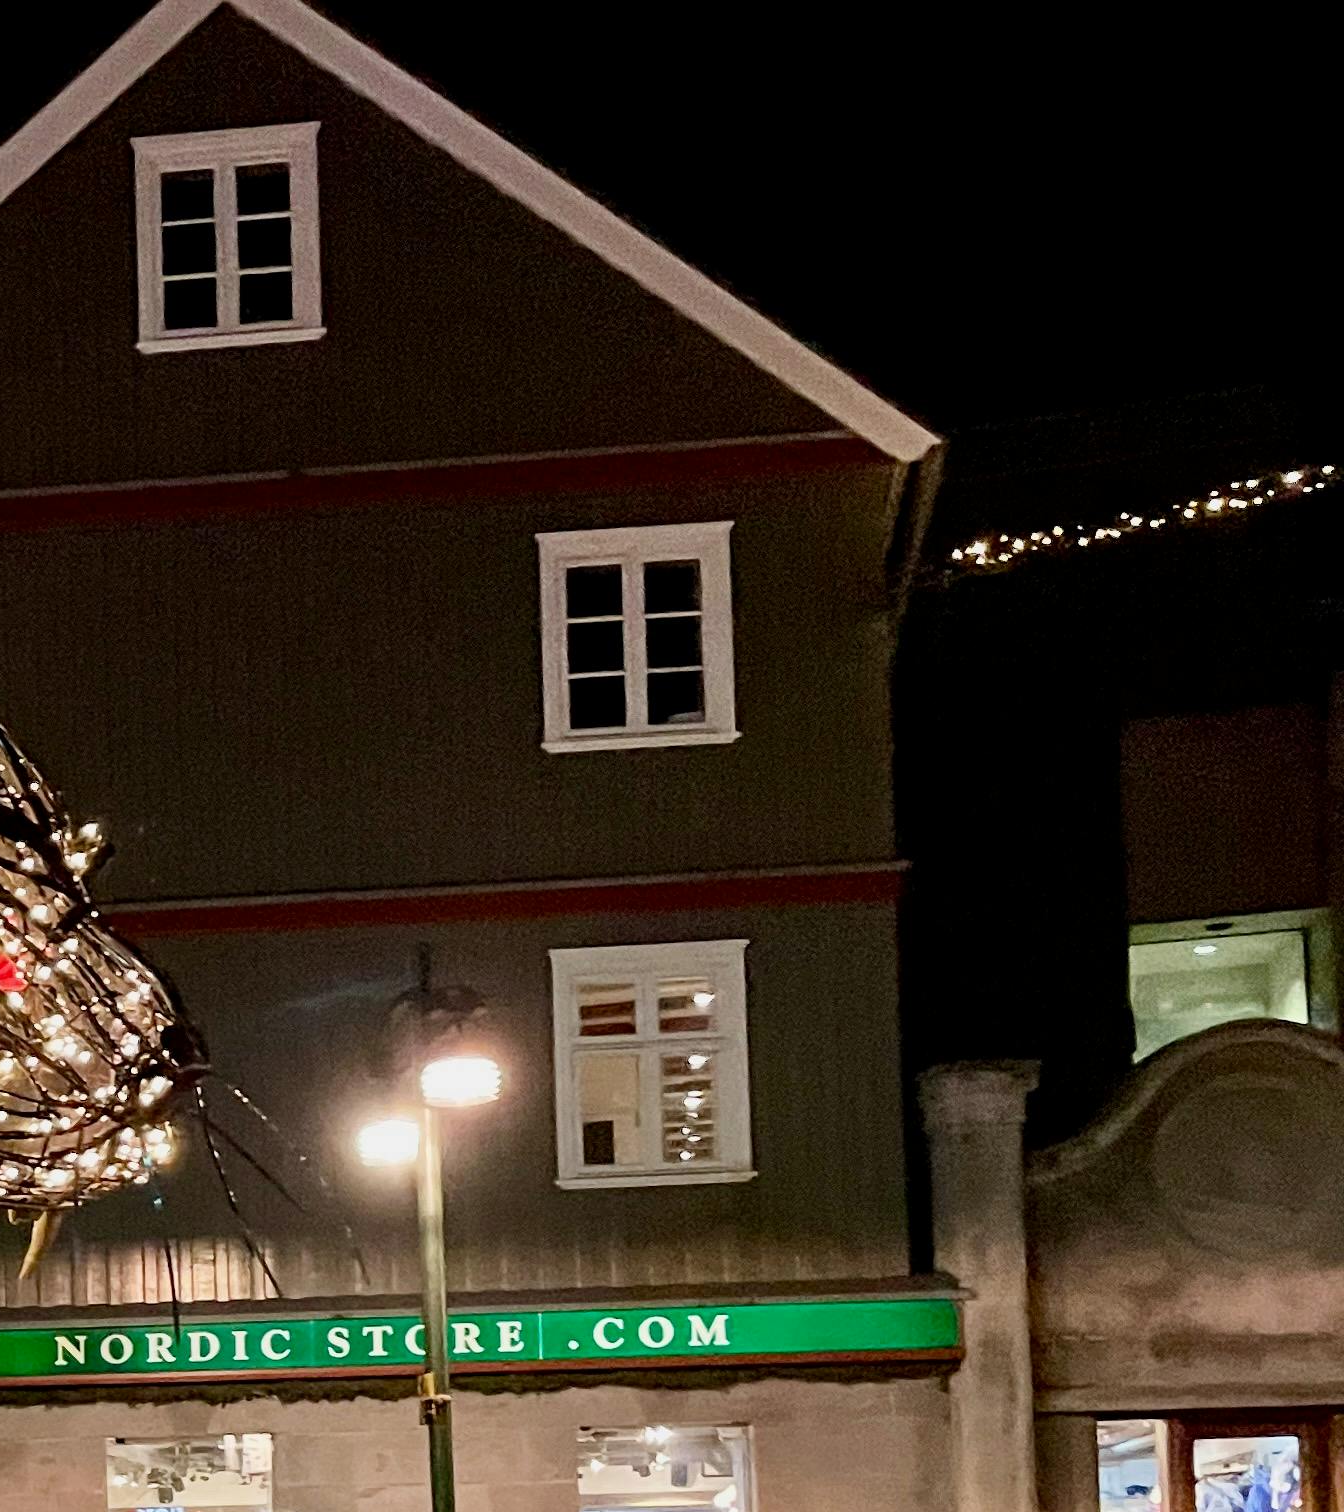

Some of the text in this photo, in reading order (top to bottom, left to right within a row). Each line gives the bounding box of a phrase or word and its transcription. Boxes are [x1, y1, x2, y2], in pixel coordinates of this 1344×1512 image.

[55, 1314, 731, 1366] NORDIC STORE .COM
